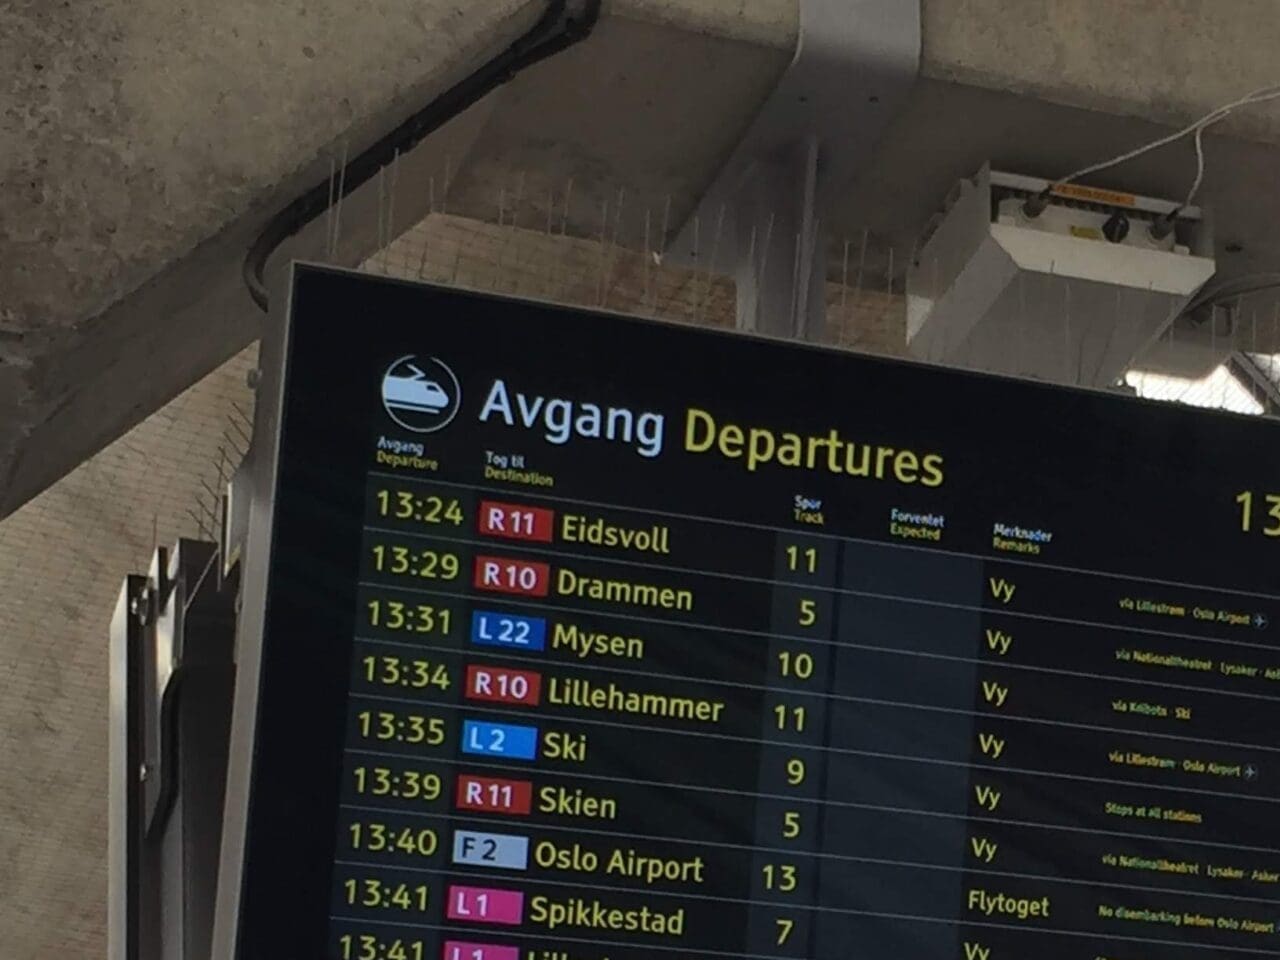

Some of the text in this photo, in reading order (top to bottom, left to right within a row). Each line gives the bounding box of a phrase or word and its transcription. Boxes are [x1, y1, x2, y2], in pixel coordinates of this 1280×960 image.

[377, 436, 424, 456] Avgang
[480, 379, 942, 486] Avgang Departures
[377, 442, 438, 470] Departure
[486, 451, 523, 468] Tog til
[485, 466, 553, 486] Destination
[795, 495, 821, 510] Spor
[795, 509, 823, 524] Track
[891, 509, 944, 527] Forventet
[891, 523, 940, 540] Expected
[994, 523, 1052, 541] Merknader
[378, 490, 463, 525] 13:24
[563, 515, 669, 553] Eidsvoll
[788, 546, 815, 572] 11
[990, 578, 1015, 602] Vy
[993, 537, 1039, 553] Remarks
[374, 546, 458, 579] 13:29
[558, 569, 692, 610] Drammen
[800, 600, 815, 625] 5
[987, 630, 1011, 654] Vy
[369, 601, 449, 634] 13:31
[553, 624, 642, 658] Mysen
[780, 652, 812, 678] 10
[983, 682, 1007, 706] Vy
[364, 657, 450, 689] 13:34
[550, 678, 724, 721] Lillehammer
[776, 705, 803, 731] 11
[980, 734, 1004, 758] Vy
[360, 712, 444, 744] 13:35
[544, 733, 585, 760] Ski
[788, 760, 803, 784] 9
[976, 786, 1000, 810] Vy
[355, 768, 440, 799] 13:39
[540, 787, 615, 818] Skien
[784, 813, 799, 837] 5
[972, 838, 996, 862] Vy
[351, 824, 436, 855] 13:40
[536, 842, 597, 871] Oslo
[607, 850, 703, 883] Airport
[763, 865, 795, 890] 13
[969, 890, 1048, 918] Flytoget
[1241, 920, 1274, 933] Airport
[346, 880, 426, 910] 13:41
[531, 897, 683, 934] Spikkestad
[777, 920, 792, 944] 7
